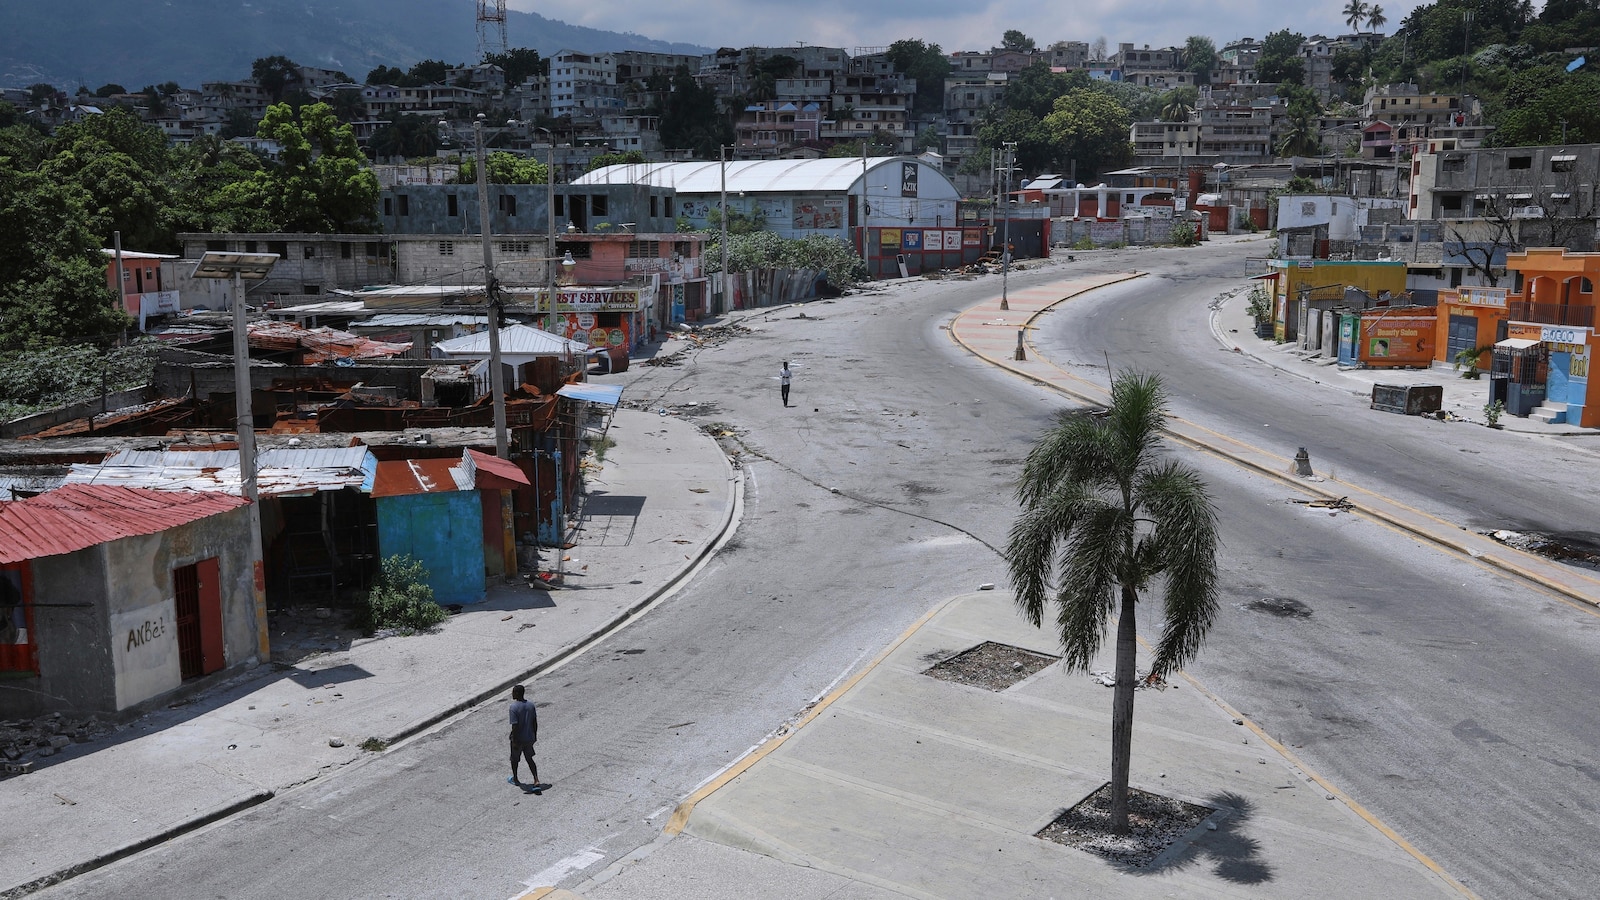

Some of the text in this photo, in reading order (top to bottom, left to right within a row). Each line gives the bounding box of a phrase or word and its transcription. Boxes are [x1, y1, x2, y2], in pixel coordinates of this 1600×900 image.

[902, 182, 917, 192] AZTK
[539, 292, 578, 305] FRST
[579, 292, 636, 304] SERVICES
[1377, 328, 1418, 338] Beauty Salon
[1547, 341, 1584, 354] LOTO
